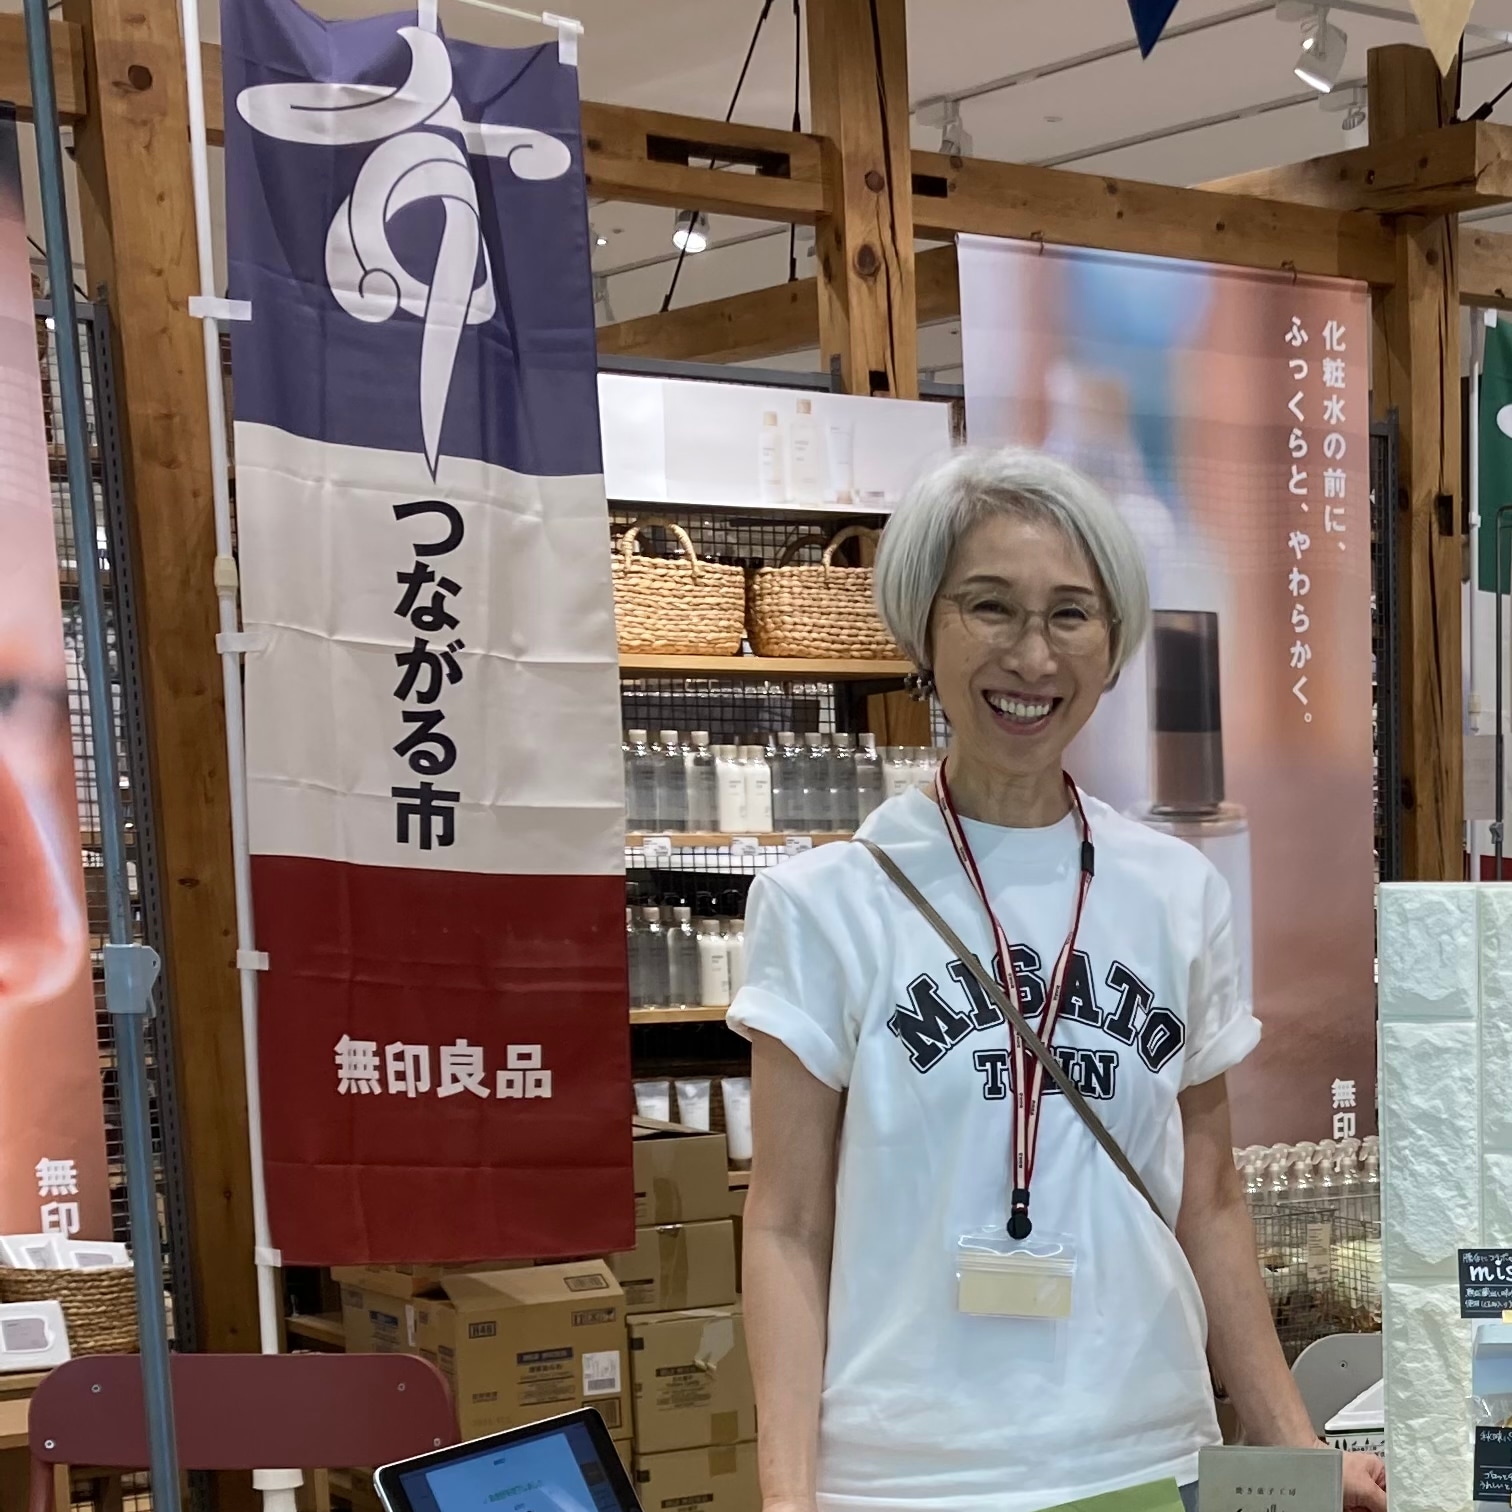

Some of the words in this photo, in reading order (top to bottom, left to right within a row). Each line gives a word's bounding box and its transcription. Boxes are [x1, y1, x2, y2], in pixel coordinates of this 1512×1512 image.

[1321, 319, 1348, 554] 化粧水の前に、
[1284, 315, 1314, 726] ふっくらと、やわらかく。
[390, 498, 466, 851] つながる市
[887, 943, 1185, 1073] MISATO
[333, 1033, 553, 1099] 無印良品
[973, 1045, 1119, 1100] TWN
[1331, 1077, 1357, 1140] 無印
[35, 1157, 80, 1240] 無印
